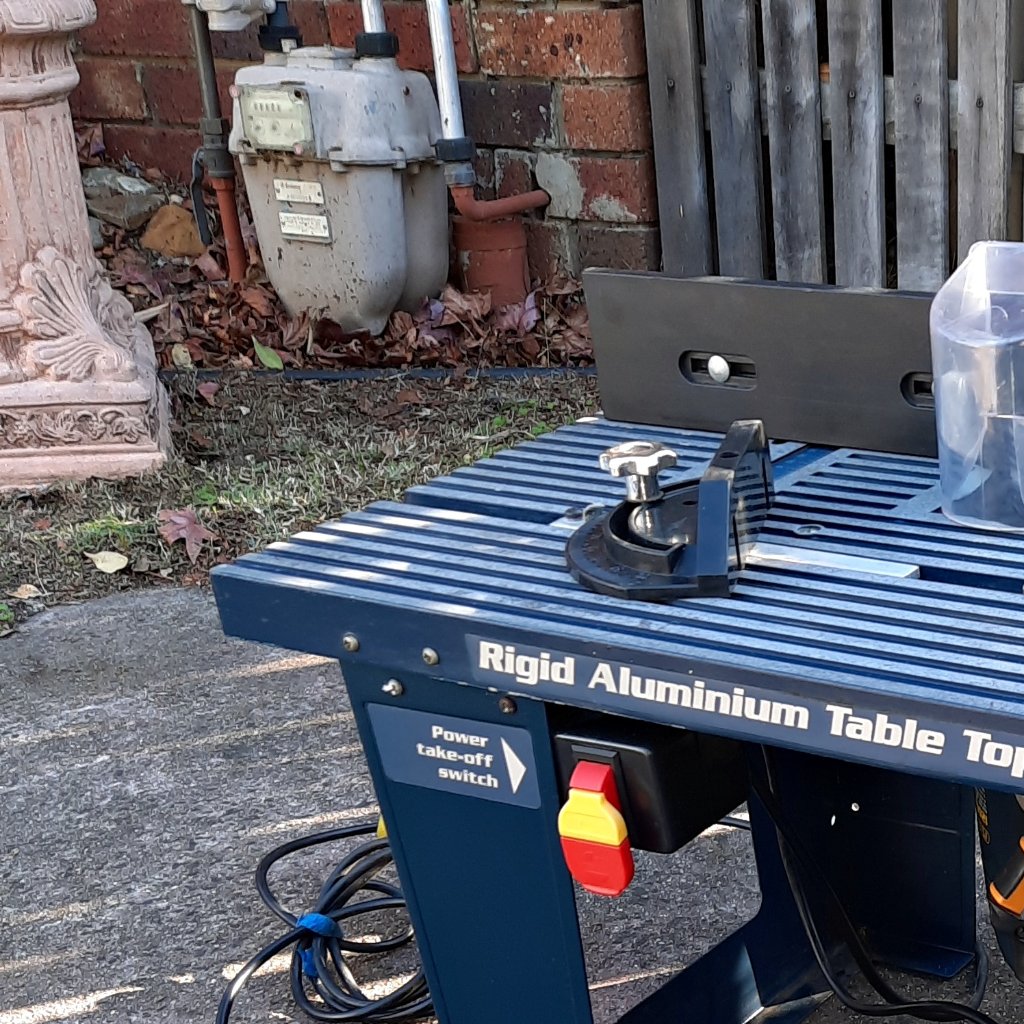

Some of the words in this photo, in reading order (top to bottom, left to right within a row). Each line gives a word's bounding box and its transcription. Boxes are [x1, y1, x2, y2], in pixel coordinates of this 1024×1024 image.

[478, 641, 575, 687] Rigid
[589, 663, 809, 731] Aluminium
[825, 704, 945, 755] Table
[431, 725, 489, 747] Power
[416, 743, 493, 768] take-off
[438, 767, 499, 788] switch
